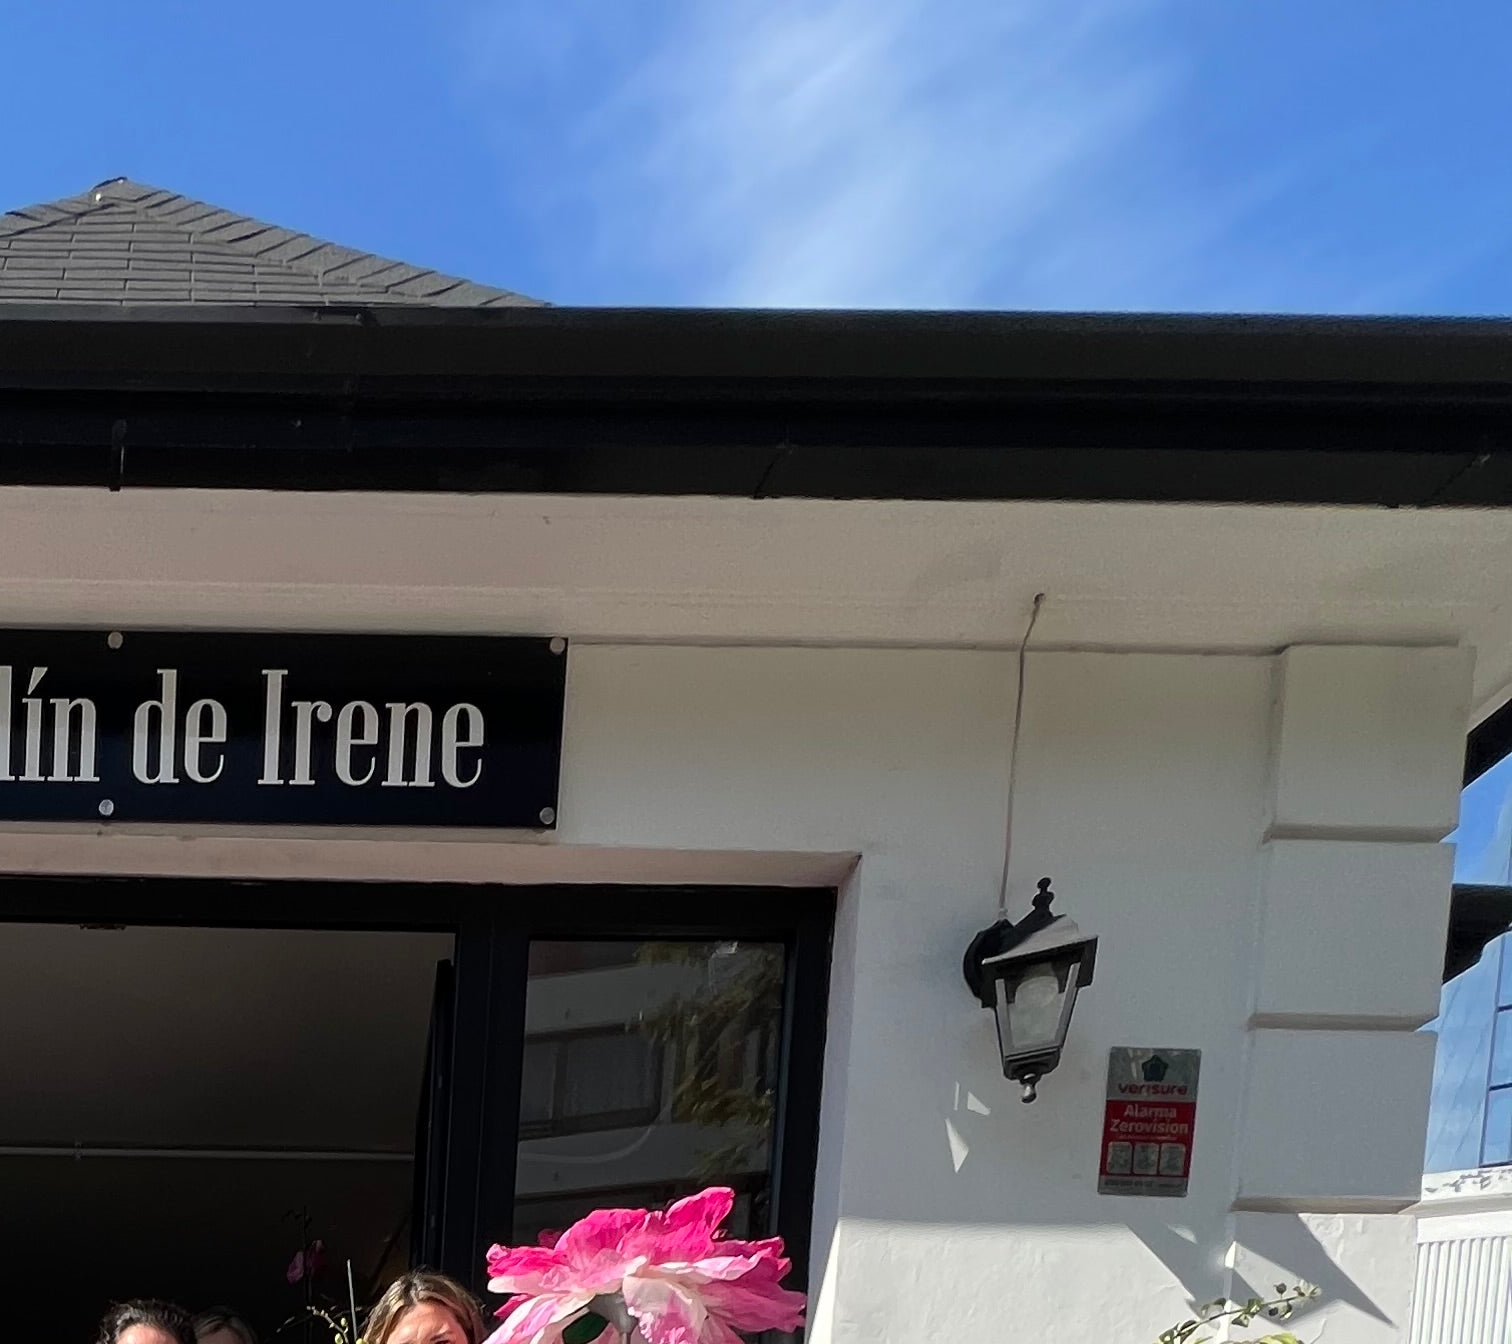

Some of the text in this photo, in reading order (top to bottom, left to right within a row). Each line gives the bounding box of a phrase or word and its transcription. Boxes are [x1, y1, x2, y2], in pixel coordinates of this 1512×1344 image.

[132, 669, 227, 784] de
[257, 669, 484, 788] Irene
[1118, 1082, 1188, 1096] verisure
[1124, 1104, 1176, 1117] Alarma
